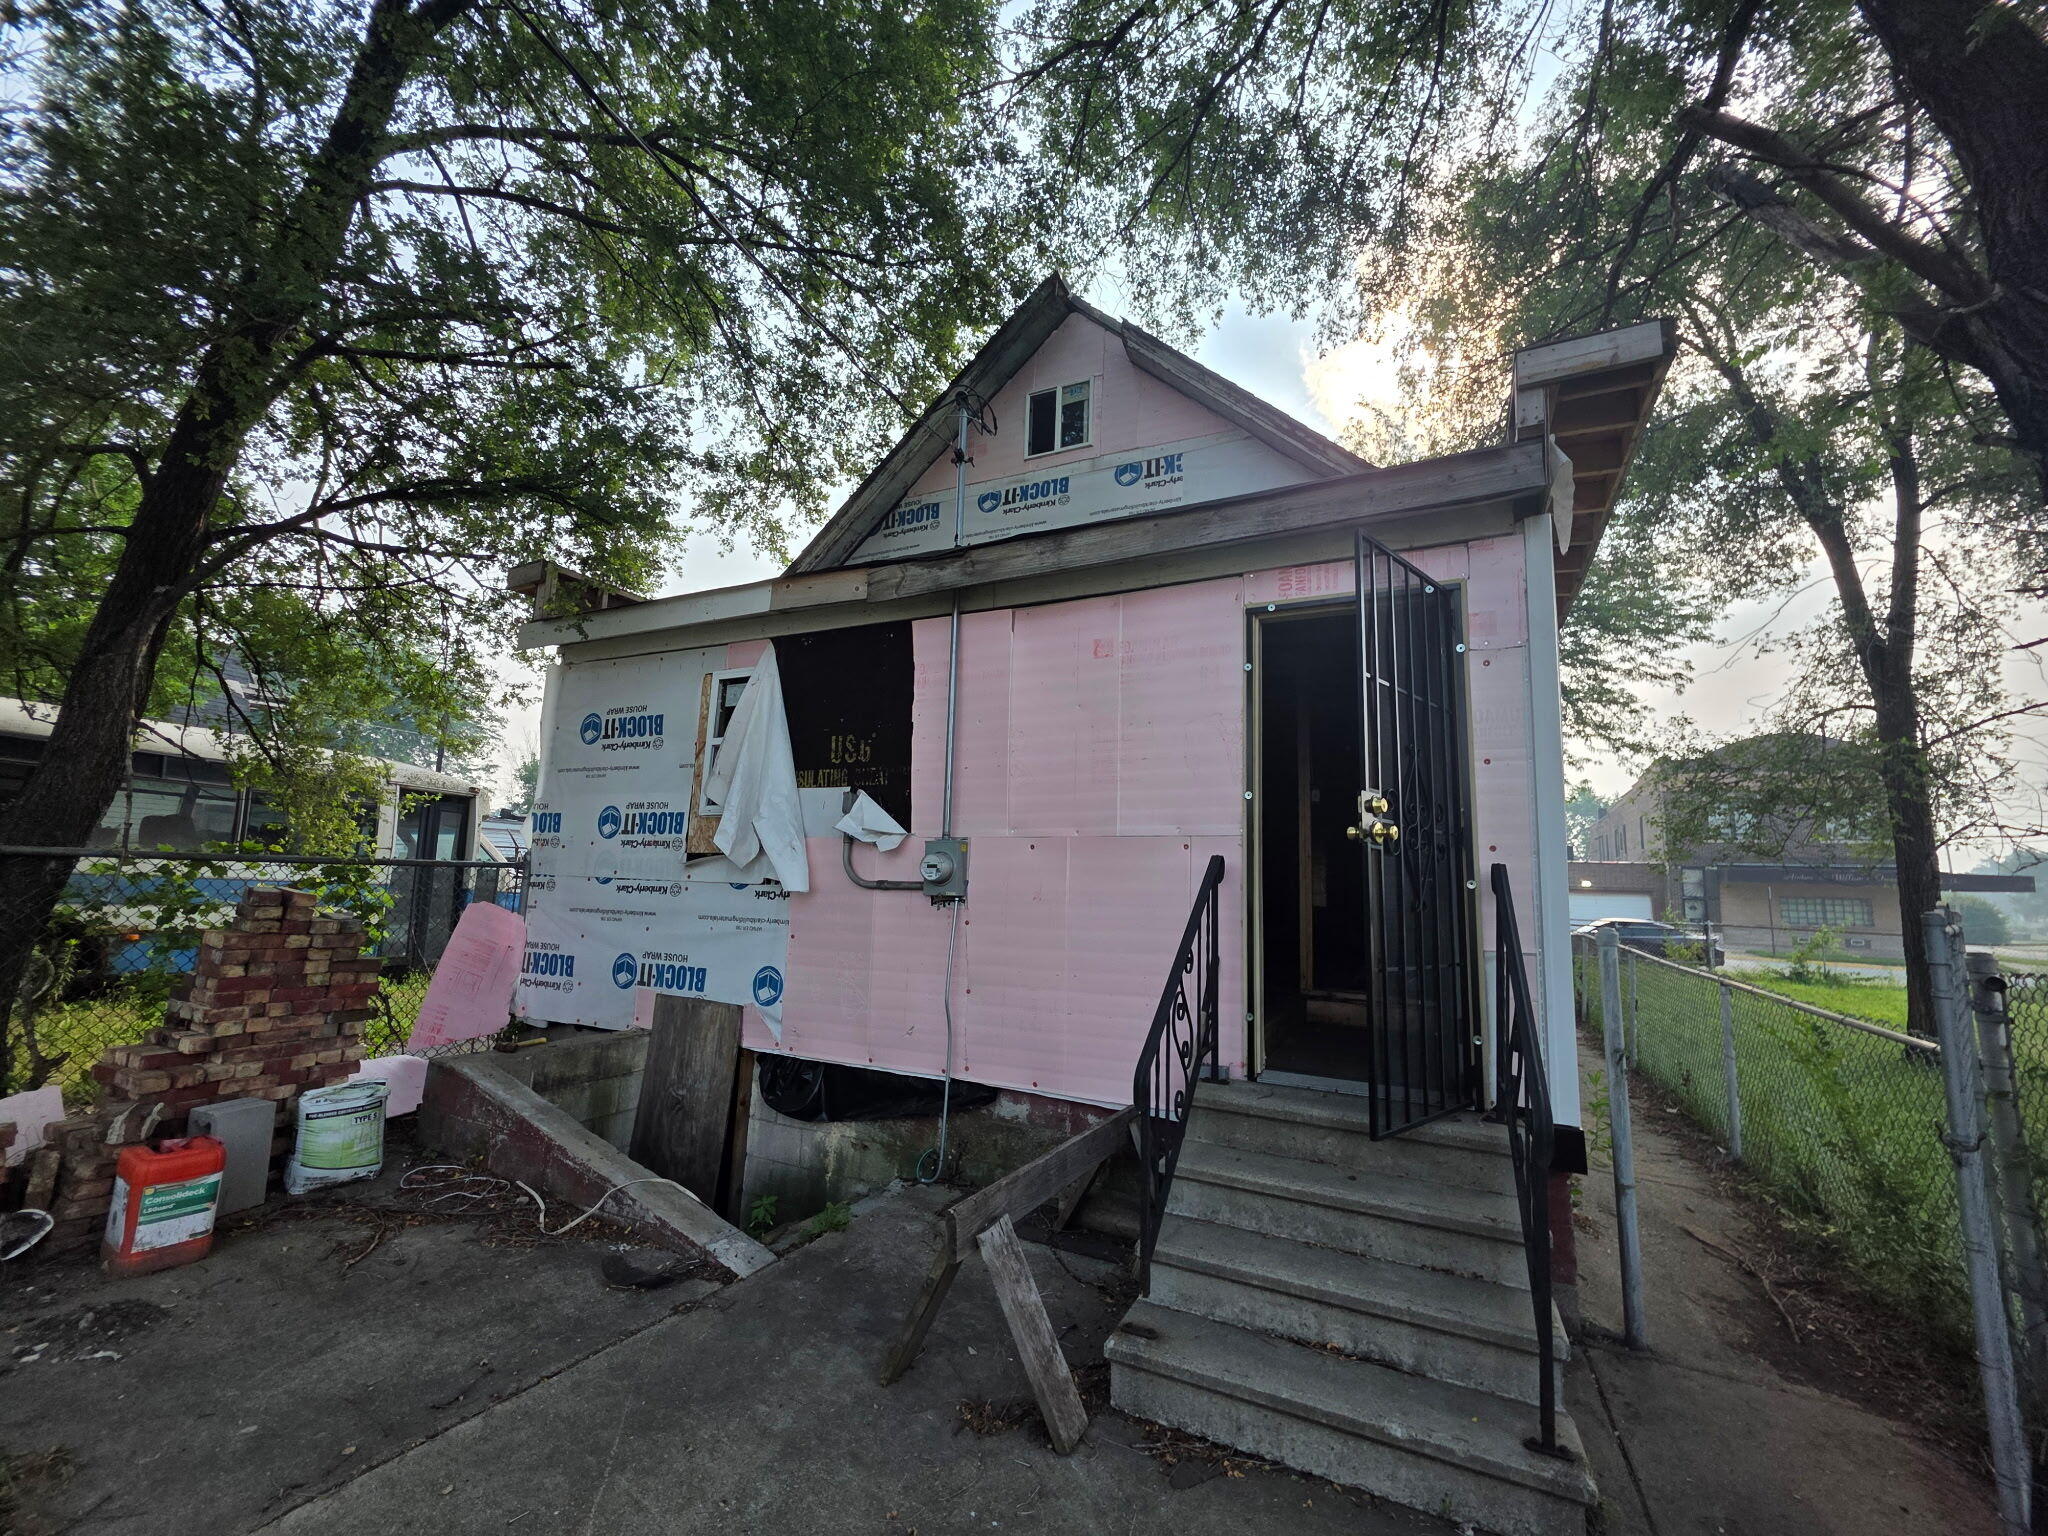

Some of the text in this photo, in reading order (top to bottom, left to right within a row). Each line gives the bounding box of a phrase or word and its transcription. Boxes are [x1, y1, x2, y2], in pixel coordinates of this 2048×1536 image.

[606, 704, 648, 715] HOUSE WRAP
[601, 739, 652, 752] Kimberly-Clark
[625, 801, 669, 810] HOUSE WRAP
[620, 838, 671, 849] Kimberly-Clark
[616, 883, 668, 895] Kimberly-Clark
[539, 942, 560, 951] HOUSE
[641, 951, 688, 963] HOUSE WRAP
[353, 1113, 374, 1124] TYPE
[144, 1187, 206, 1205] Consolideck
